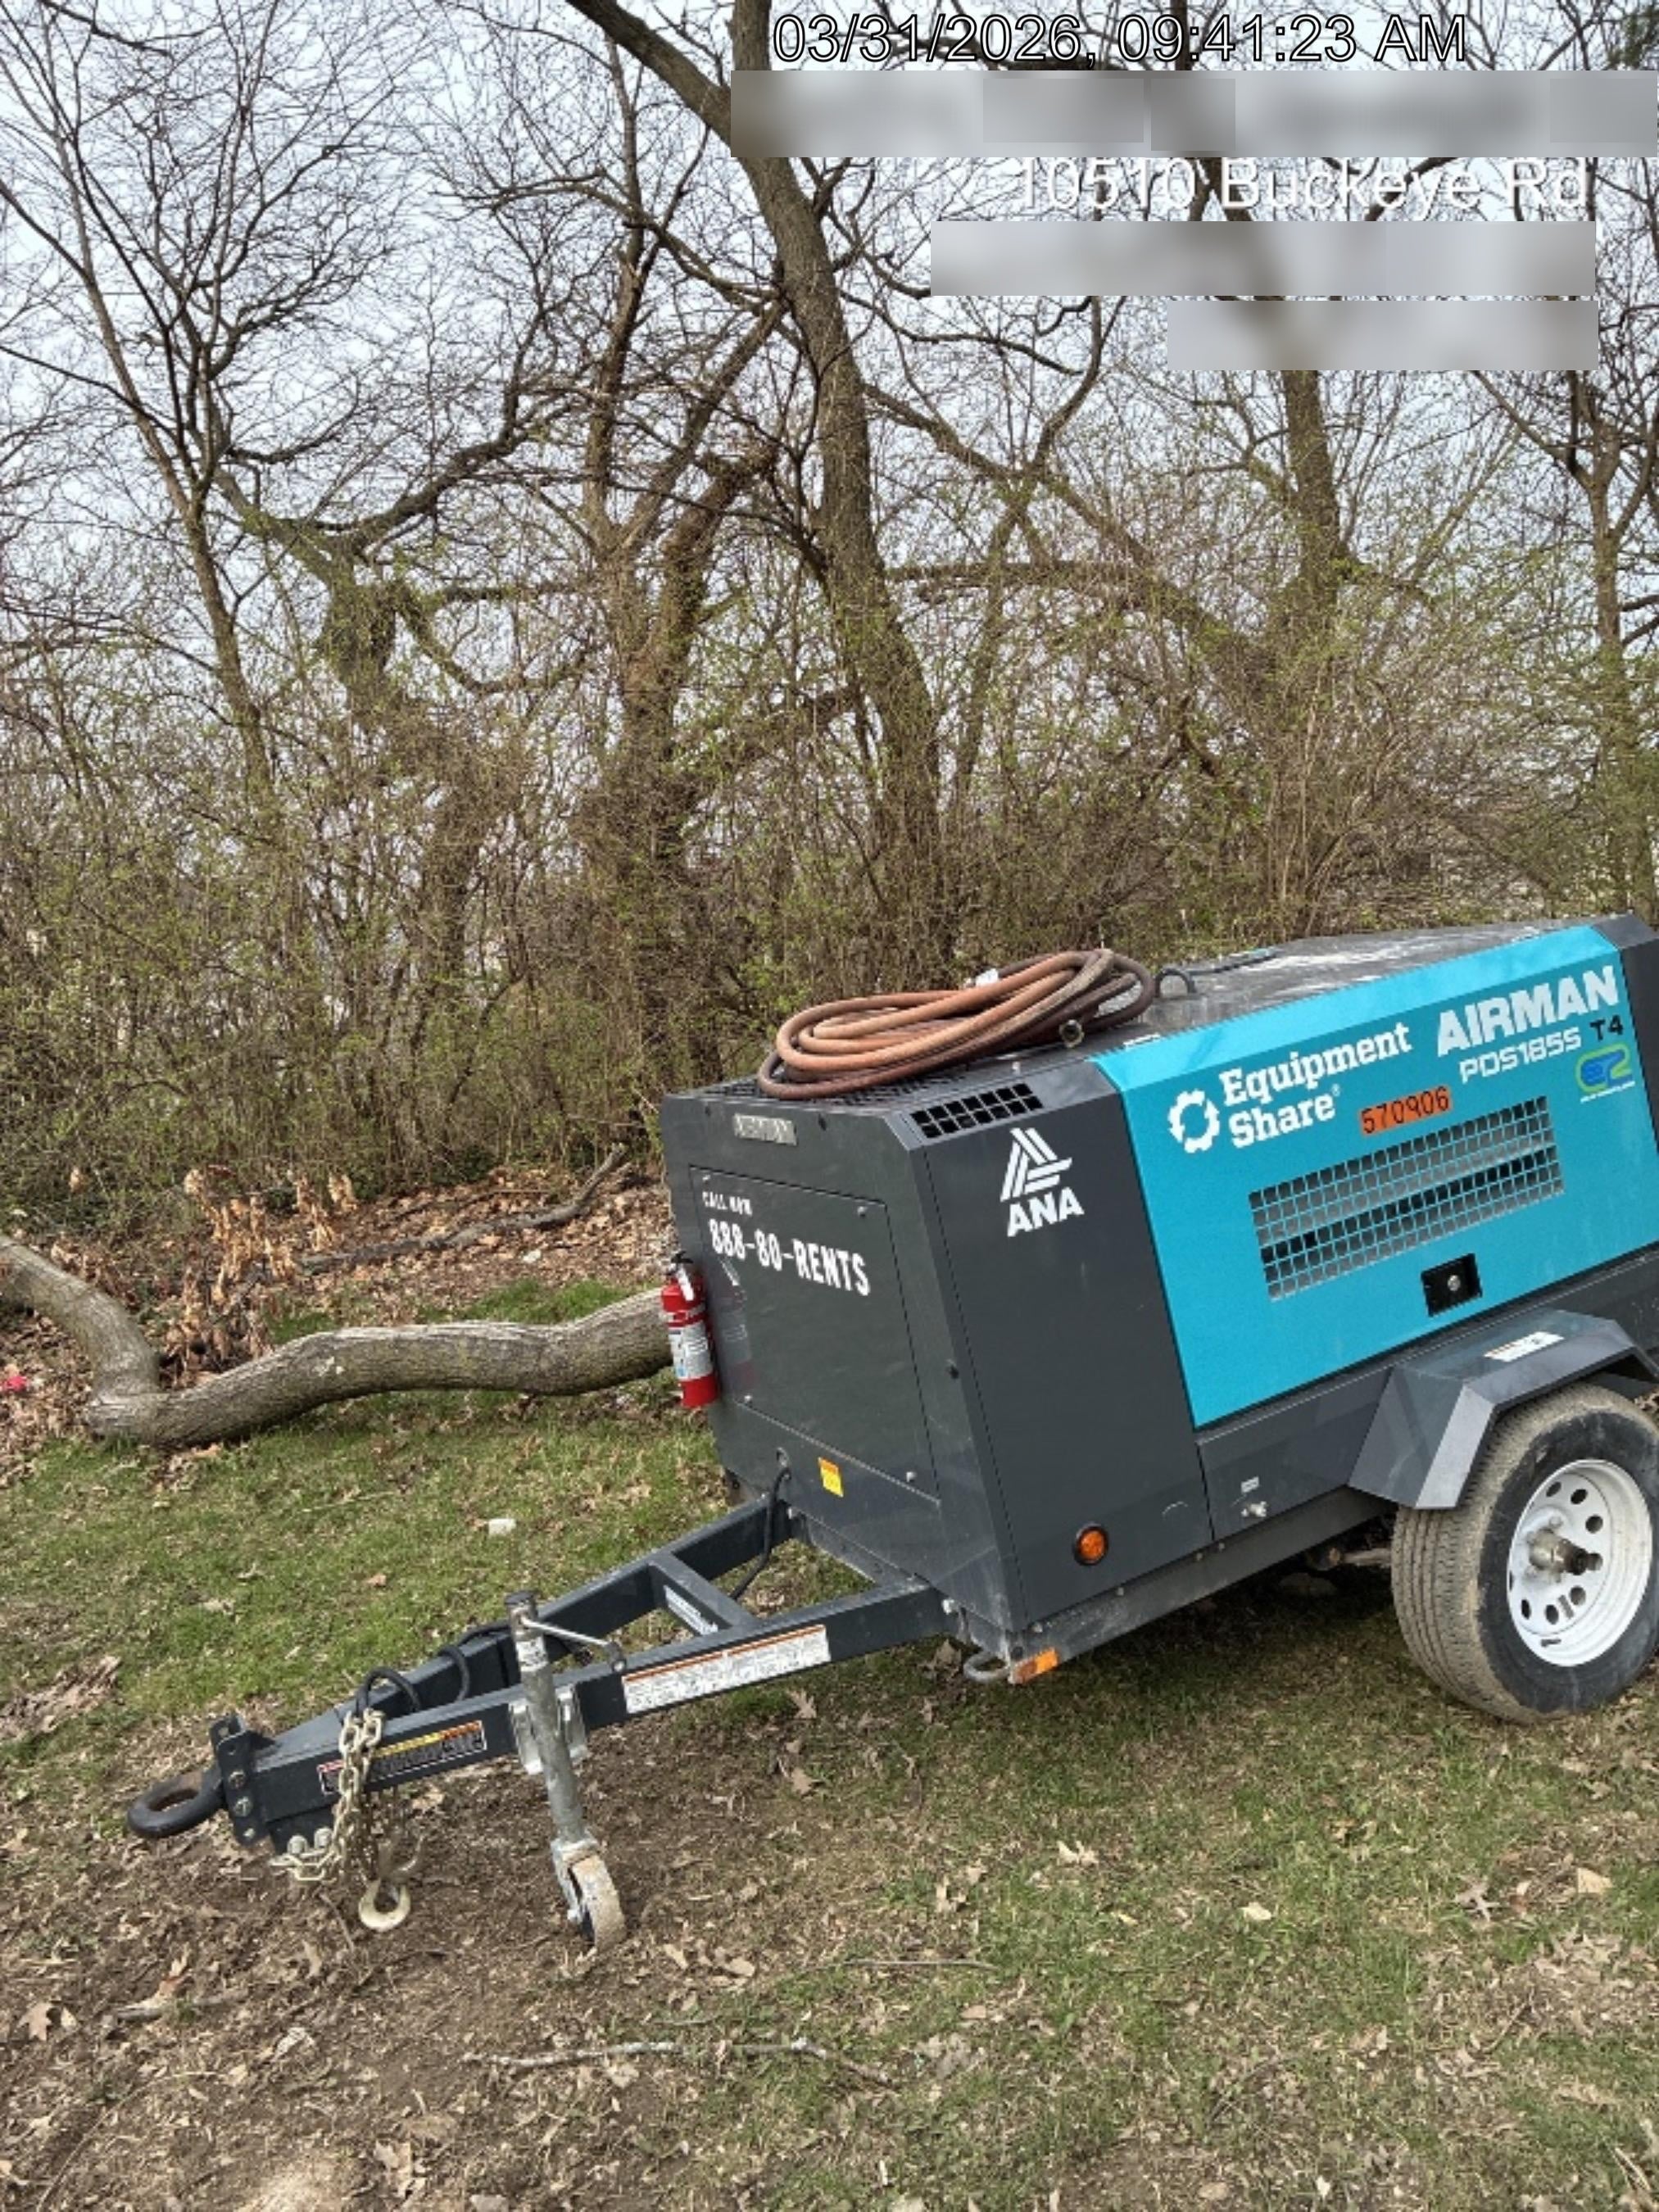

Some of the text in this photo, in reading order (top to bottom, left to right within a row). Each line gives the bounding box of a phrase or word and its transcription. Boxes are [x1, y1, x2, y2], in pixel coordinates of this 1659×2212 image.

[1438, 965, 1619, 1058] AIRMAN
[1219, 1022, 1412, 1105] Equipment
[1459, 1014, 1624, 1085] PDS185S T4
[1361, 1086, 1451, 1135] 570906
[1006, 1186, 1085, 1237] ANA
[708, 1218, 871, 1296] 888-80-RENTS
